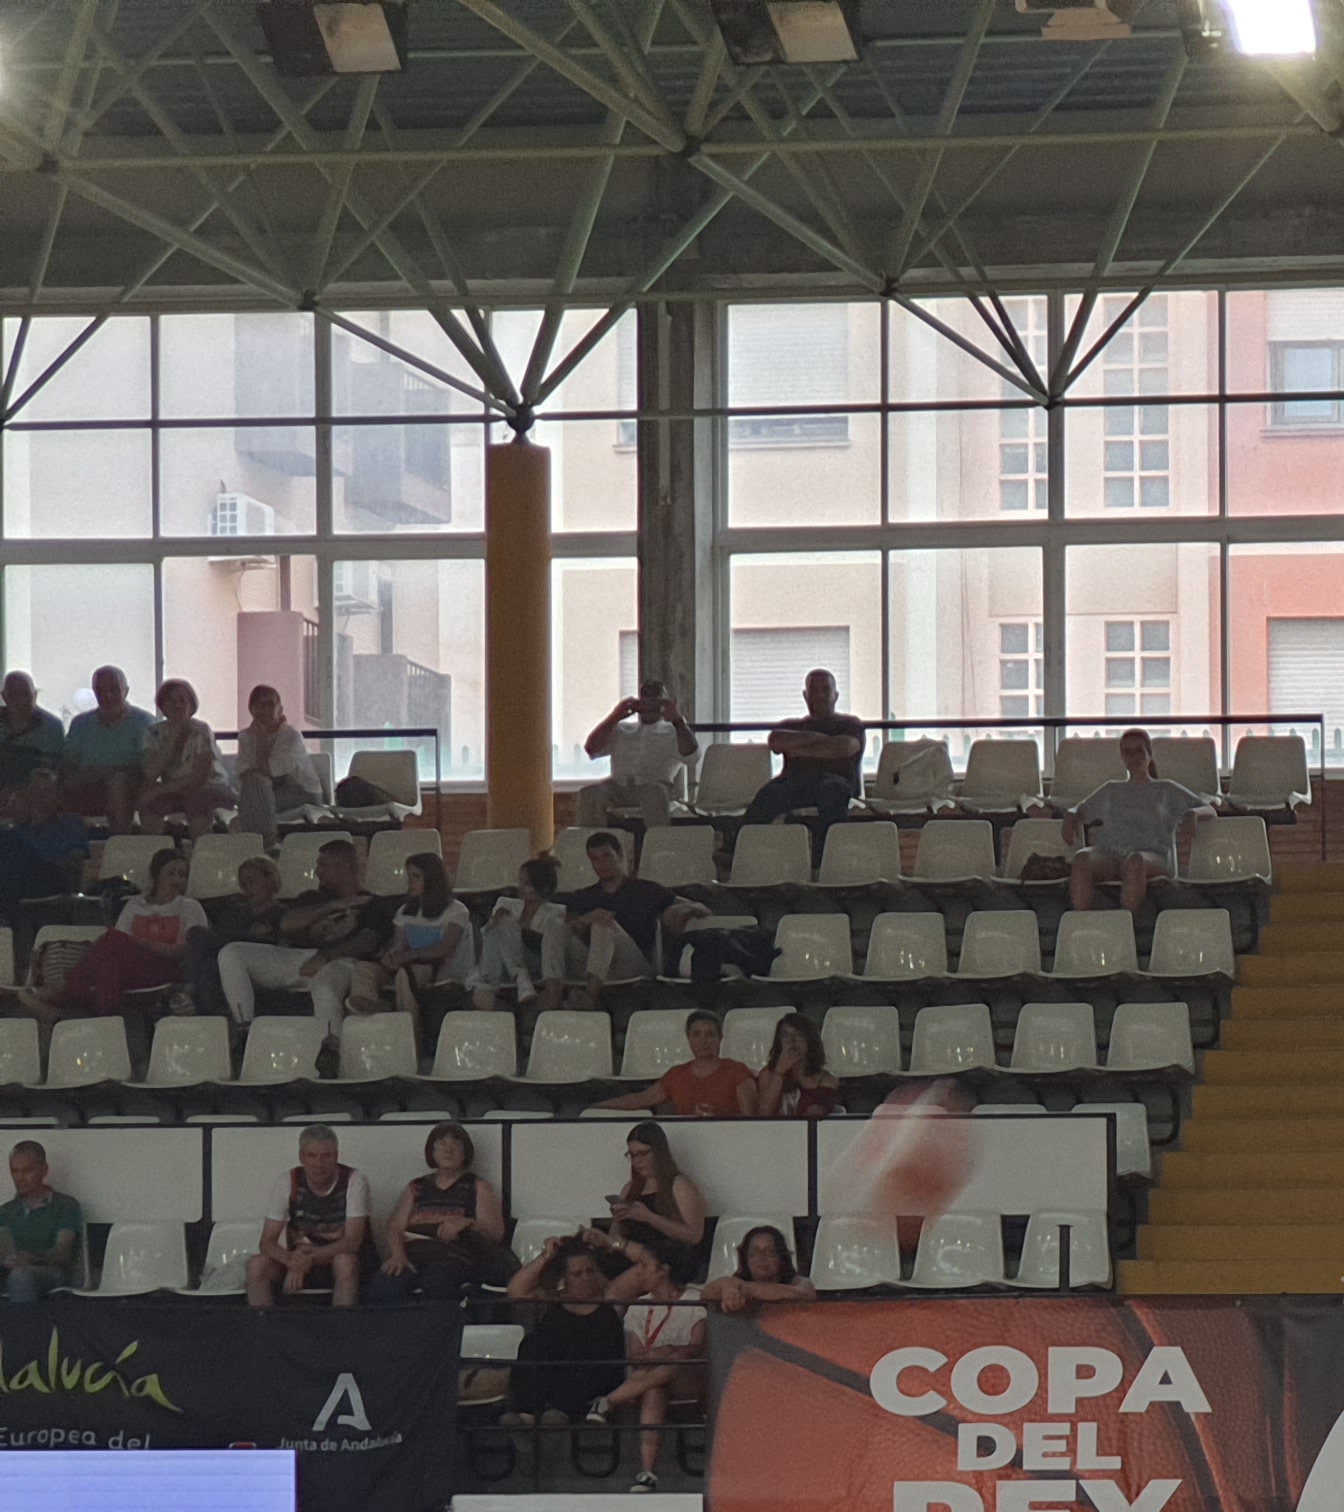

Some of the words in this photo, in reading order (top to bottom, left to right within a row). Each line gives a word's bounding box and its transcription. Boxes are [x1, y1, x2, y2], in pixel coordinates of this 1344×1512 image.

[869, 1345, 1212, 1416] COPA
[108, 1430, 150, 1449] del
[320, 1438, 337, 1451] de
[957, 1422, 1122, 1471] DEL
